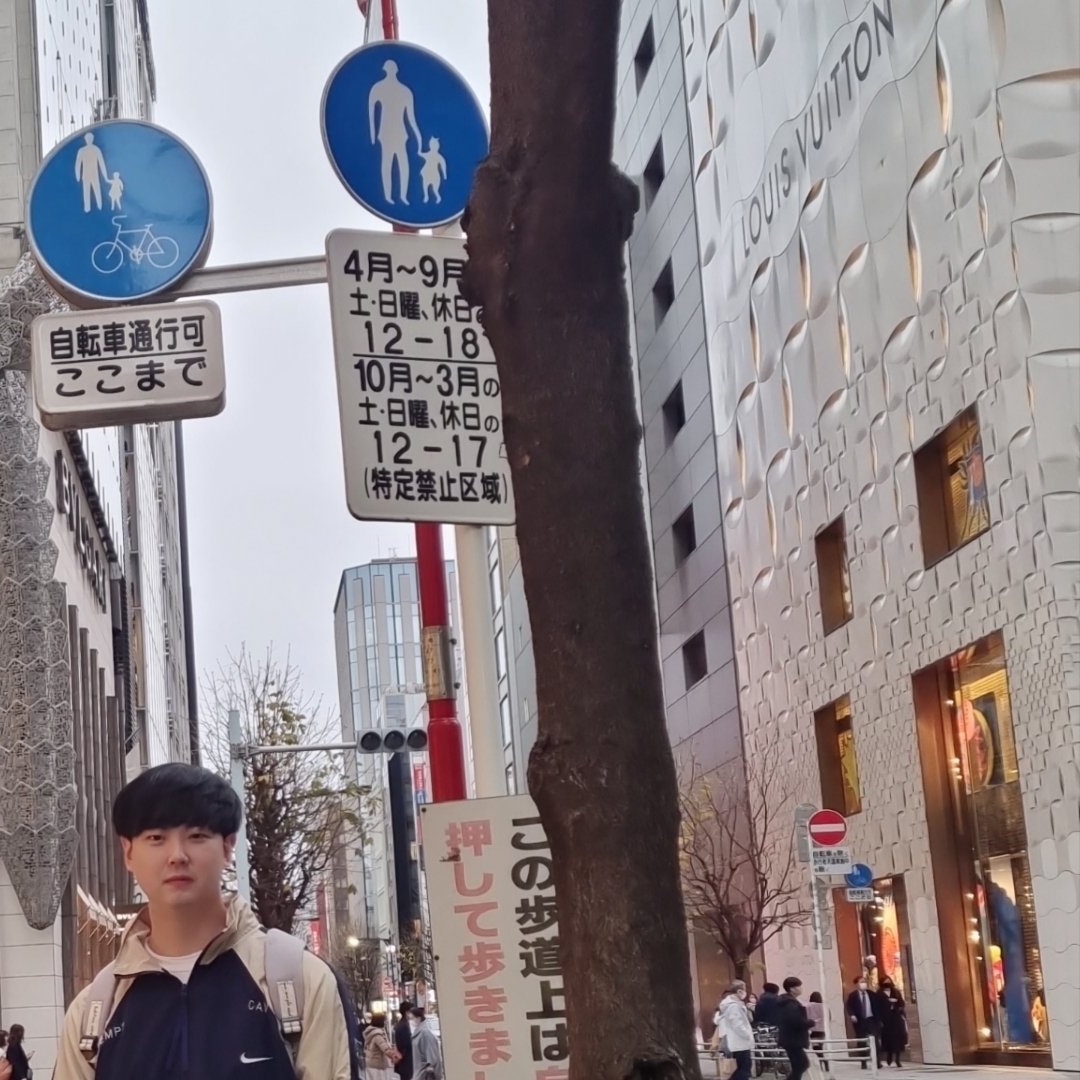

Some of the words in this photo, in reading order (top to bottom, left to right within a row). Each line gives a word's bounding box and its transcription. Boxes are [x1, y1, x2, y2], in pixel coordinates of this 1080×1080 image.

[741, 147, 792, 259] LOUIS
[795, 0, 895, 169] VUITTON
[49, 314, 206, 360] 自転車通行可
[55, 356, 207, 397] ここまで
